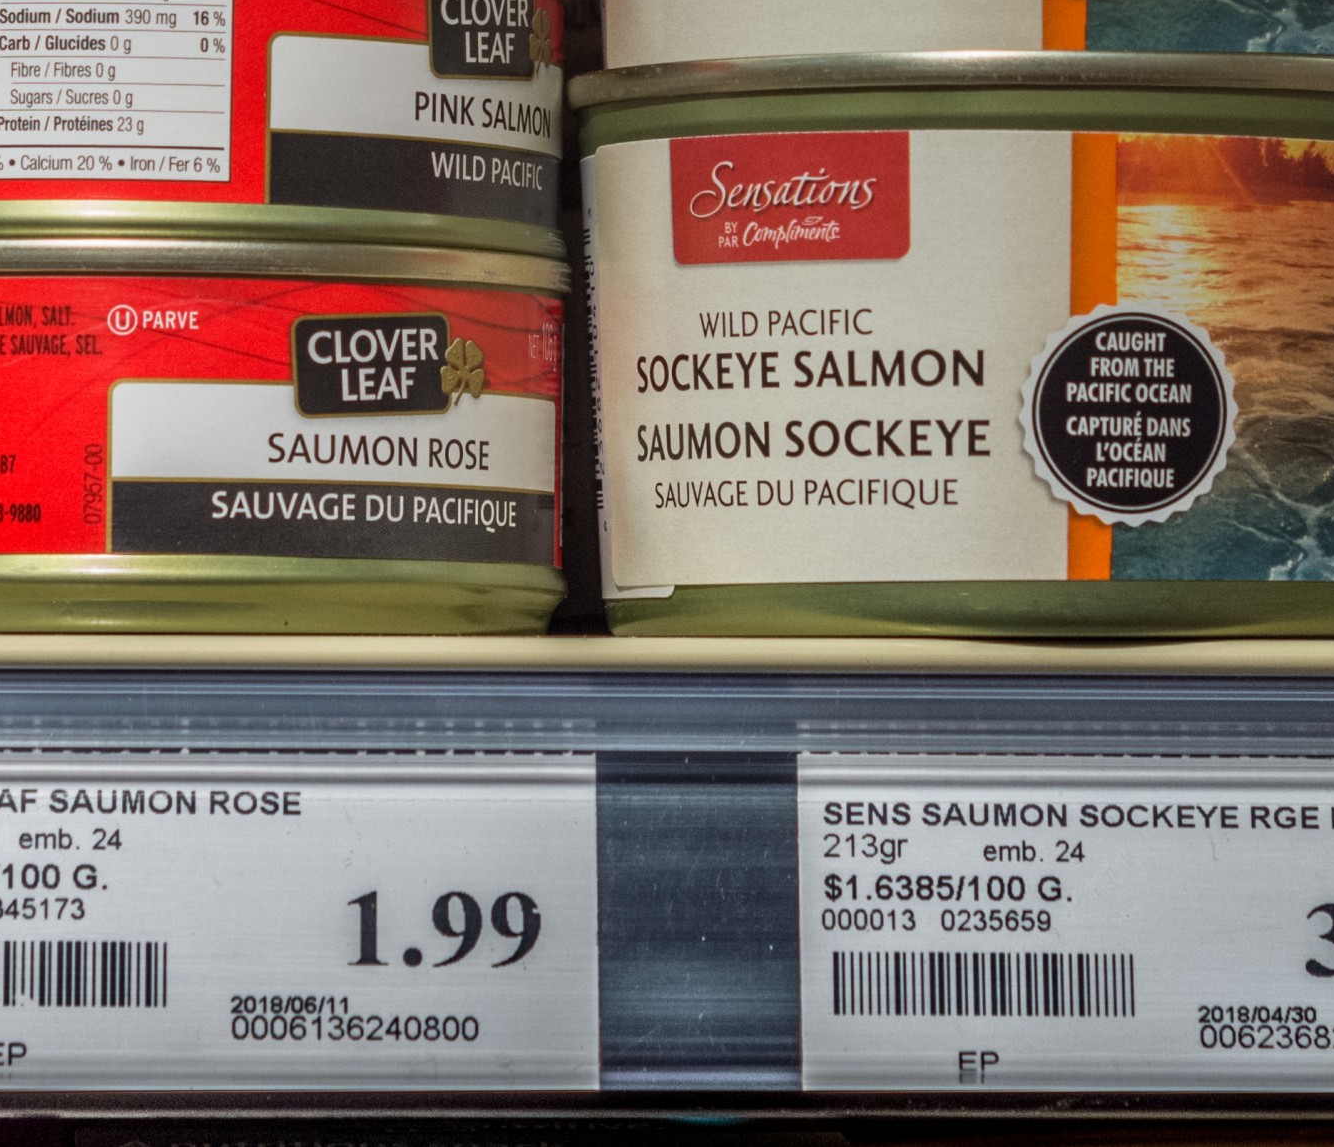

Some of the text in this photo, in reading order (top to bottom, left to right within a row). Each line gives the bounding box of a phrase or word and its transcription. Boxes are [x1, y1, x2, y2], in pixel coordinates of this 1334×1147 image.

[0, 9, 151, 24] Sodium Sodium 390
[54, 116, 113, 131] Protéines
[415, 92, 550, 139] PINK SALMON
[21, 155, 72, 171] Calcium
[431, 151, 542, 190] WILD PACIFIC
[690, 161, 877, 218] Sensations
[1067, 411, 1191, 437] CAPTURÉ DANS
[268, 432, 489, 470] SAUMON ROSE
[1087, 468, 1174, 488] PACIFIQUE
[49, 789, 196, 814] SAUMON
[210, 790, 300, 816] ROSE
[824, 802, 911, 826] SENS
[922, 804, 1067, 826] SAUMON
[1079, 805, 1239, 828] SOCKEYE
[1250, 806, 1319, 830] RGE
[19, 830, 80, 850] emb.
[92, 829, 122, 850] 24
[824, 834, 1085, 864] 213gr emb. 24
[72, 865, 108, 890] G.
[824, 874, 1072, 902] $1.6385/100 G.
[347, 891, 541, 968] 1.99
[822, 909, 1051, 931] 000013 0235659
[231, 996, 349, 1014] 2018/06/11
[1198, 1006, 1317, 1023] 2018/04/30
[231, 1016, 478, 1041] 0006136240800
[959, 1052, 999, 1072] EP
